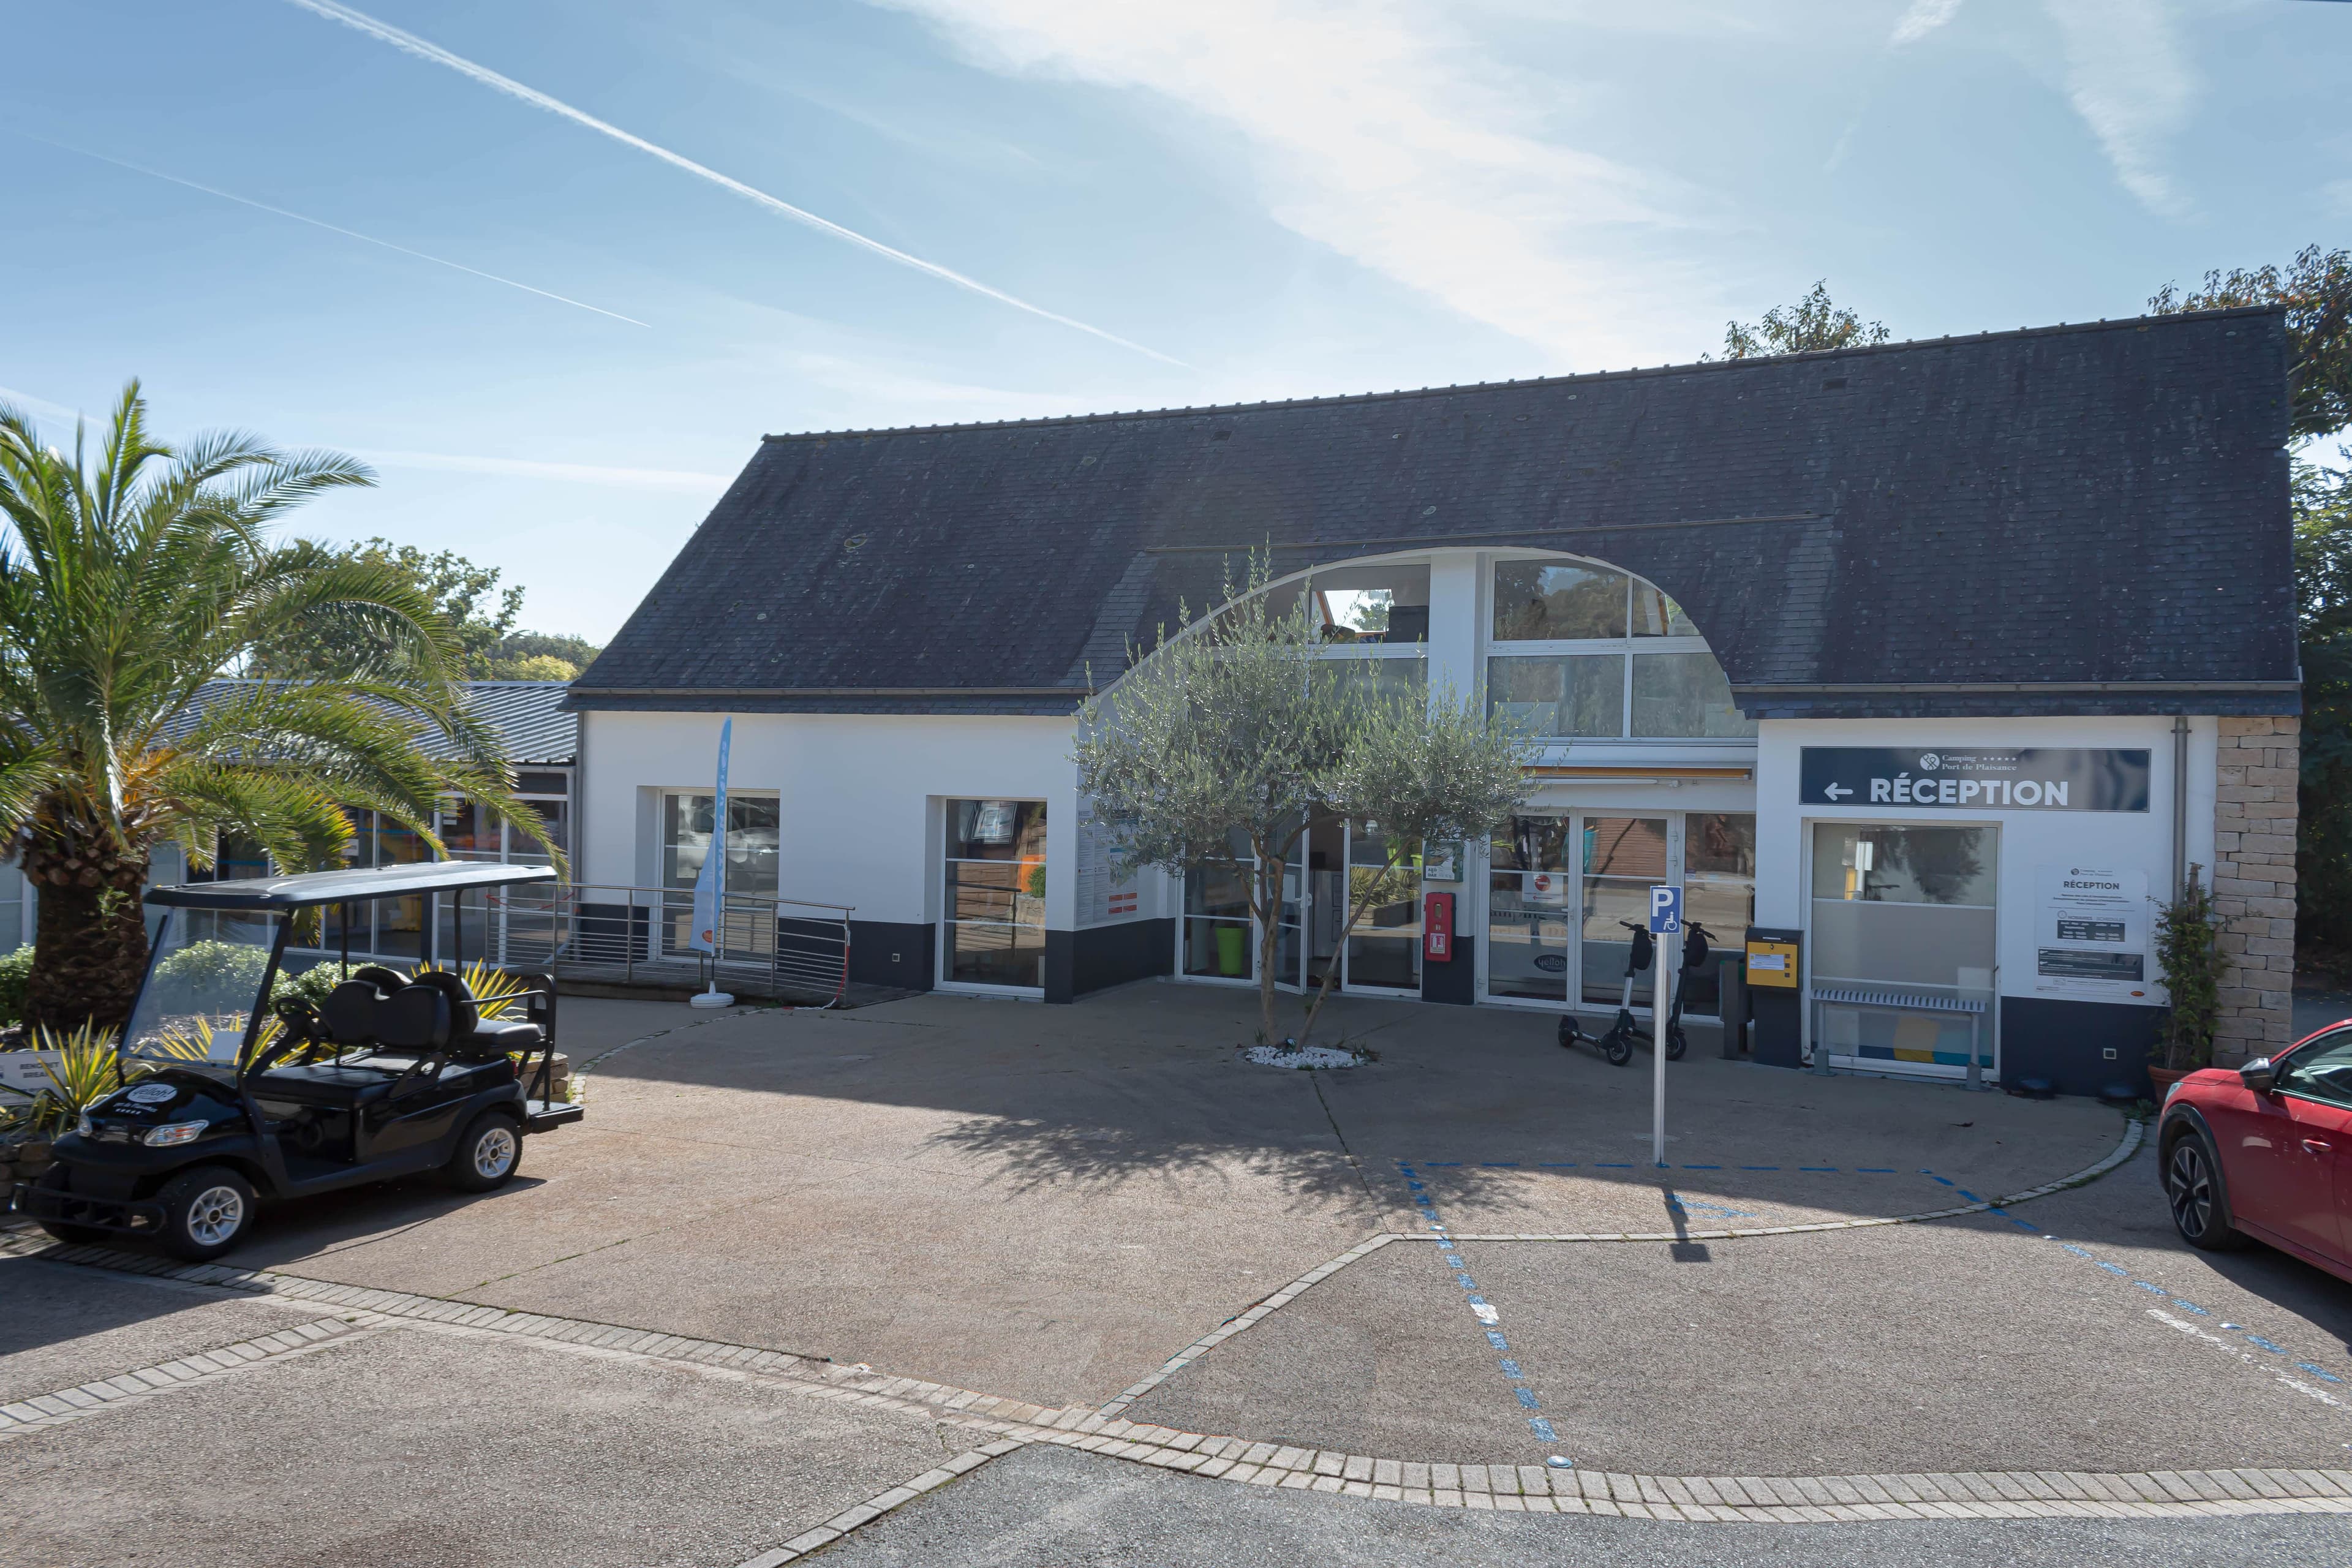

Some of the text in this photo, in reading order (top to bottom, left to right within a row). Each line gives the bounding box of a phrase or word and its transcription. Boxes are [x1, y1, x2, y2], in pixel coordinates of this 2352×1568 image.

[1942, 755, 1977, 763] Camping
[1870, 772, 2068, 806] RÉCEPTION
[2063, 880, 2120, 890] RÉCEPTION
[1652, 889, 1674, 917] P
